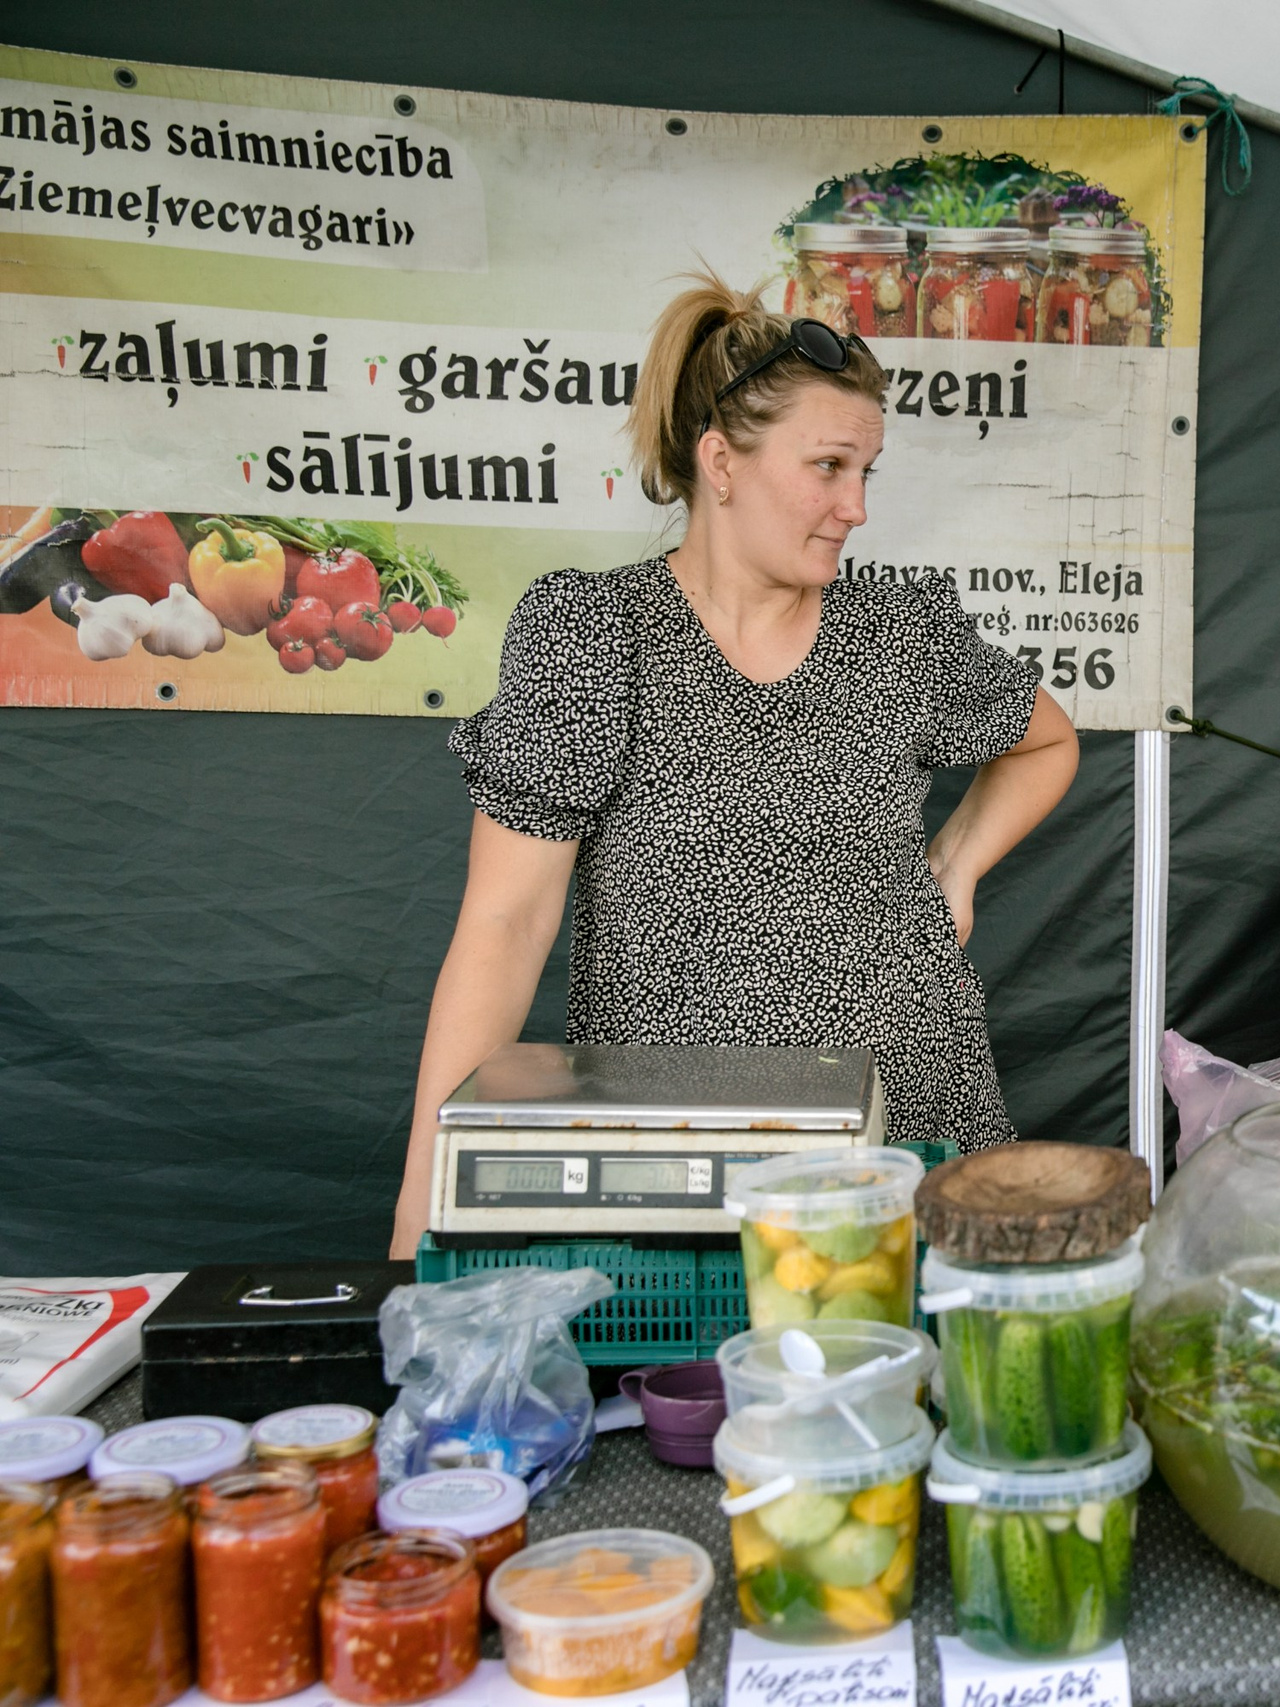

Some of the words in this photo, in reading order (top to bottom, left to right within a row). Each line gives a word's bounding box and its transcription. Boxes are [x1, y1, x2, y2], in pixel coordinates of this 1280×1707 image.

[0, 100, 151, 156] mājas
[167, 120, 453, 179] saimniecība
[0, 165, 415, 250] Ziemeļvecvagari»
[79, 319, 328, 407] zaļumi
[266, 431, 559, 511] sālījumi
[969, 567, 1046, 596] nov.,
[1059, 561, 1144, 602] Eleja
[1025, 611, 1140, 634] nr:063626
[567, 1170, 584, 1184] kg
